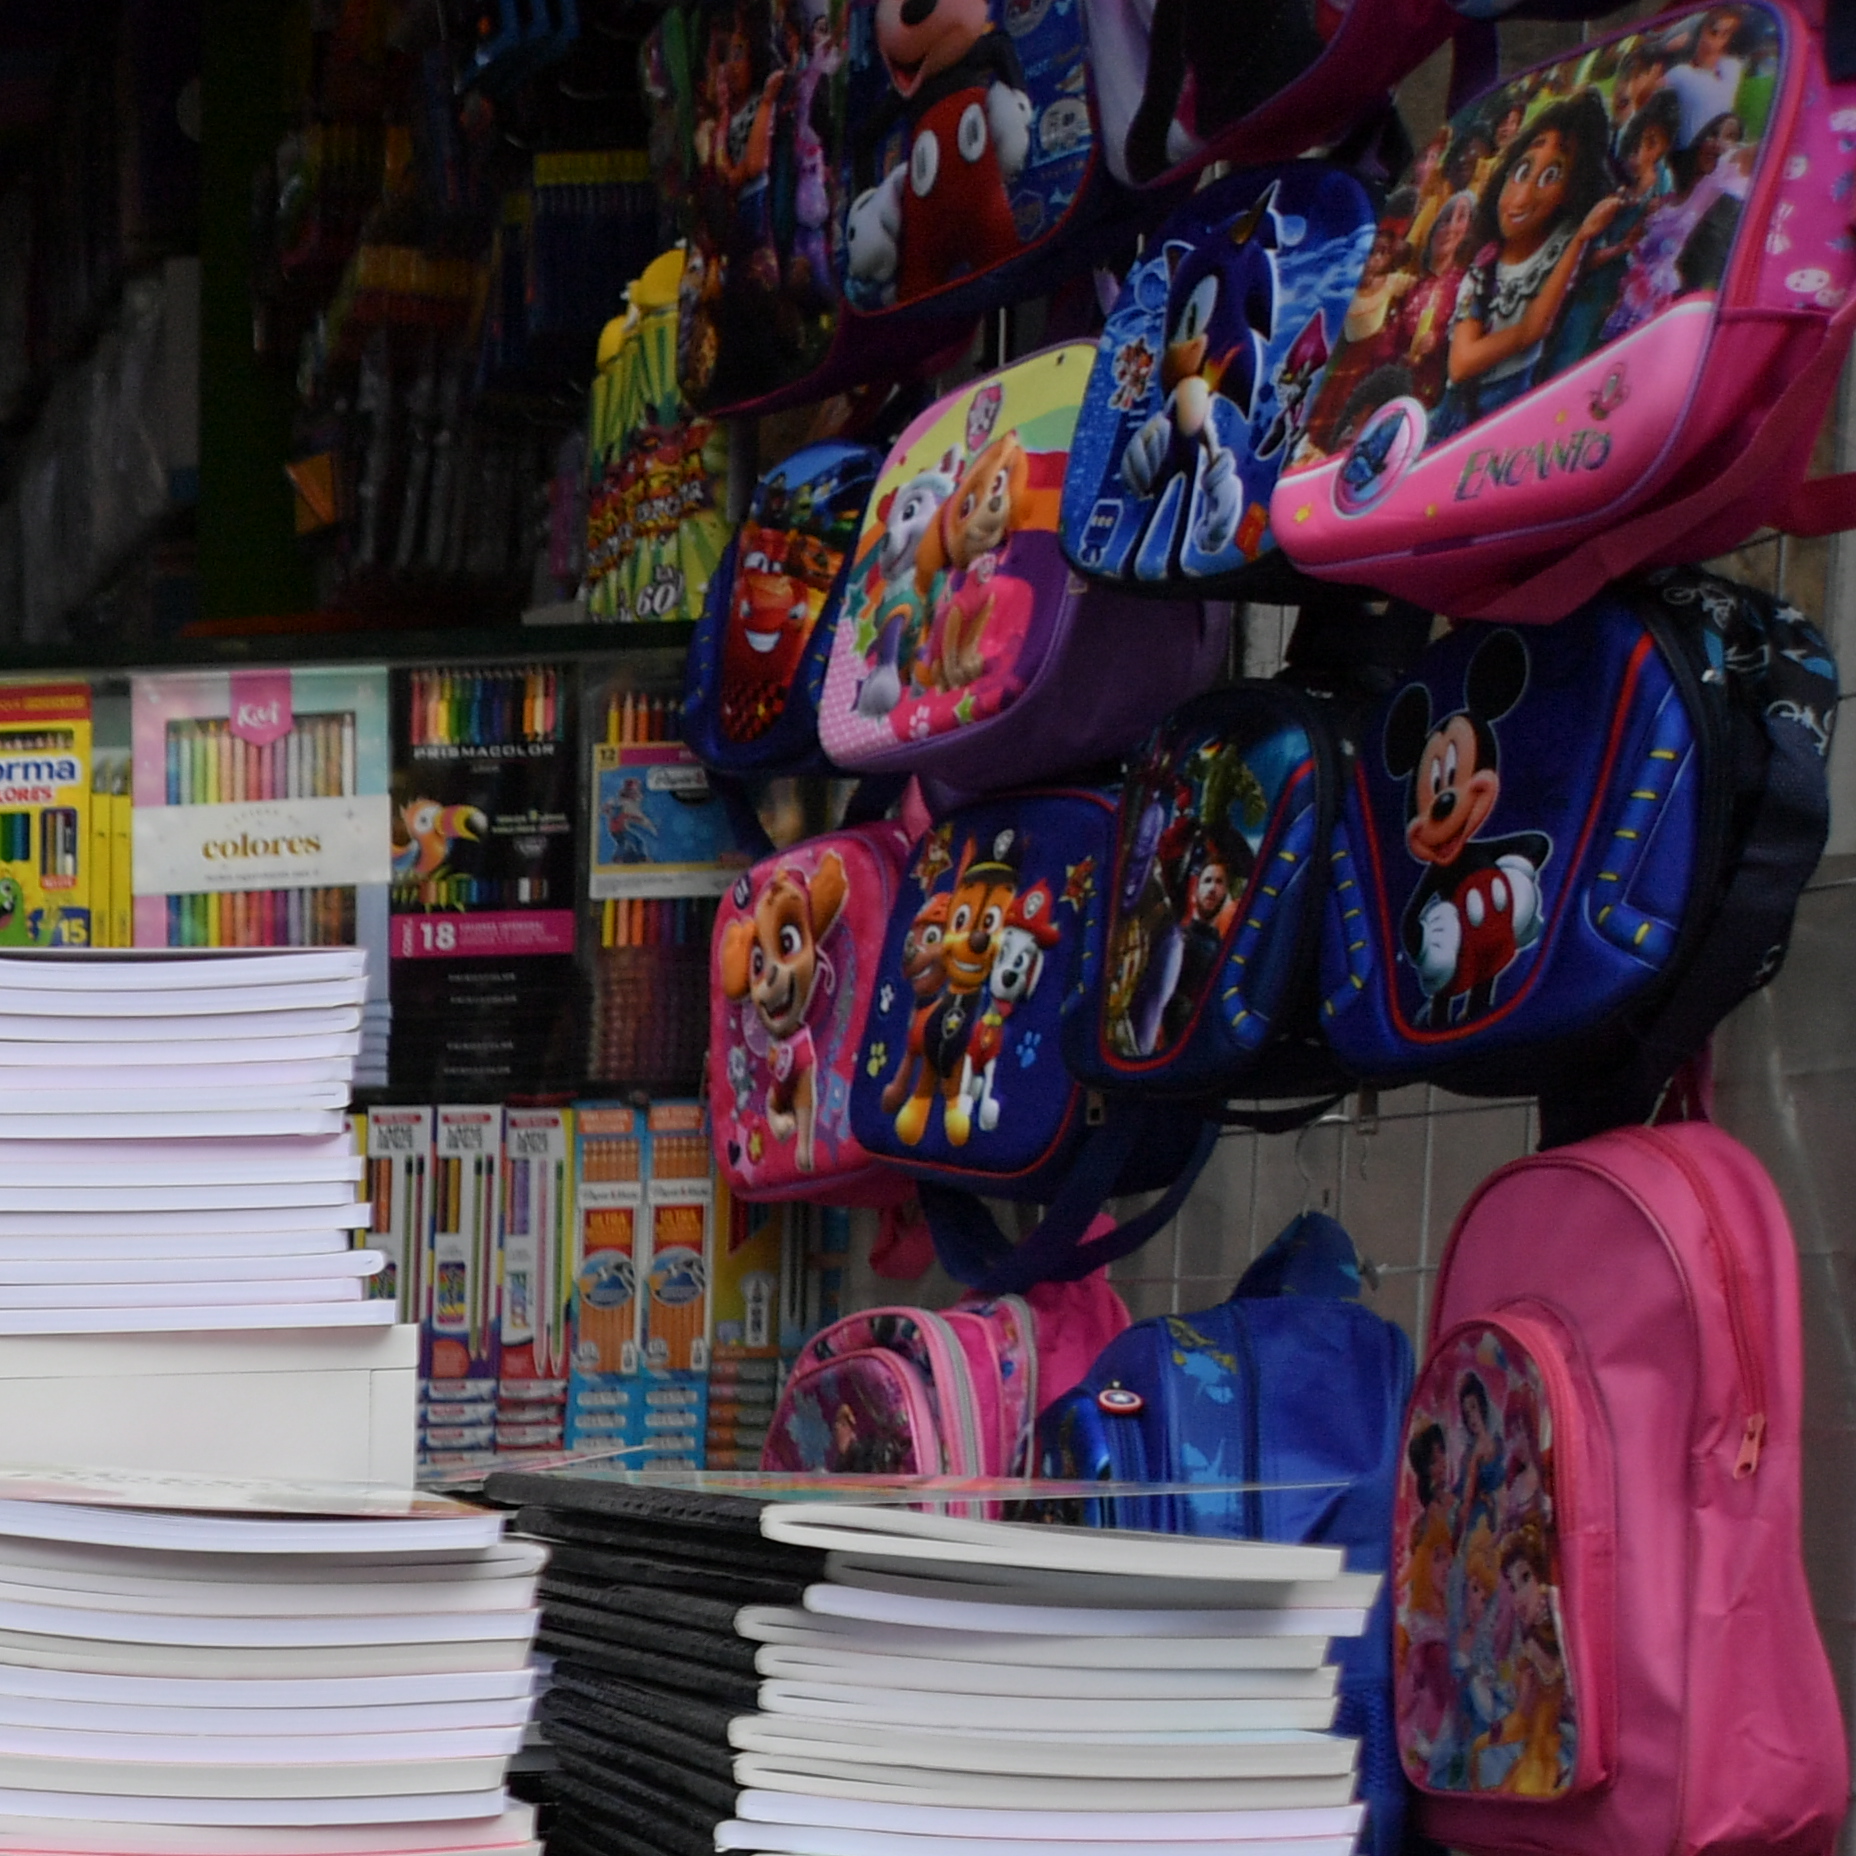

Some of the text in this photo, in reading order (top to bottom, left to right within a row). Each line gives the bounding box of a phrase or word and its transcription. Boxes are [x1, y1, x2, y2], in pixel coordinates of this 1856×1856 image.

[1454, 428, 1612, 502] ENCANTO
[413, 744, 555, 760] PRISMACOLOR
[201, 831, 322, 861] colores
[59, 918, 88, 944] 15
[420, 921, 457, 951] 18
